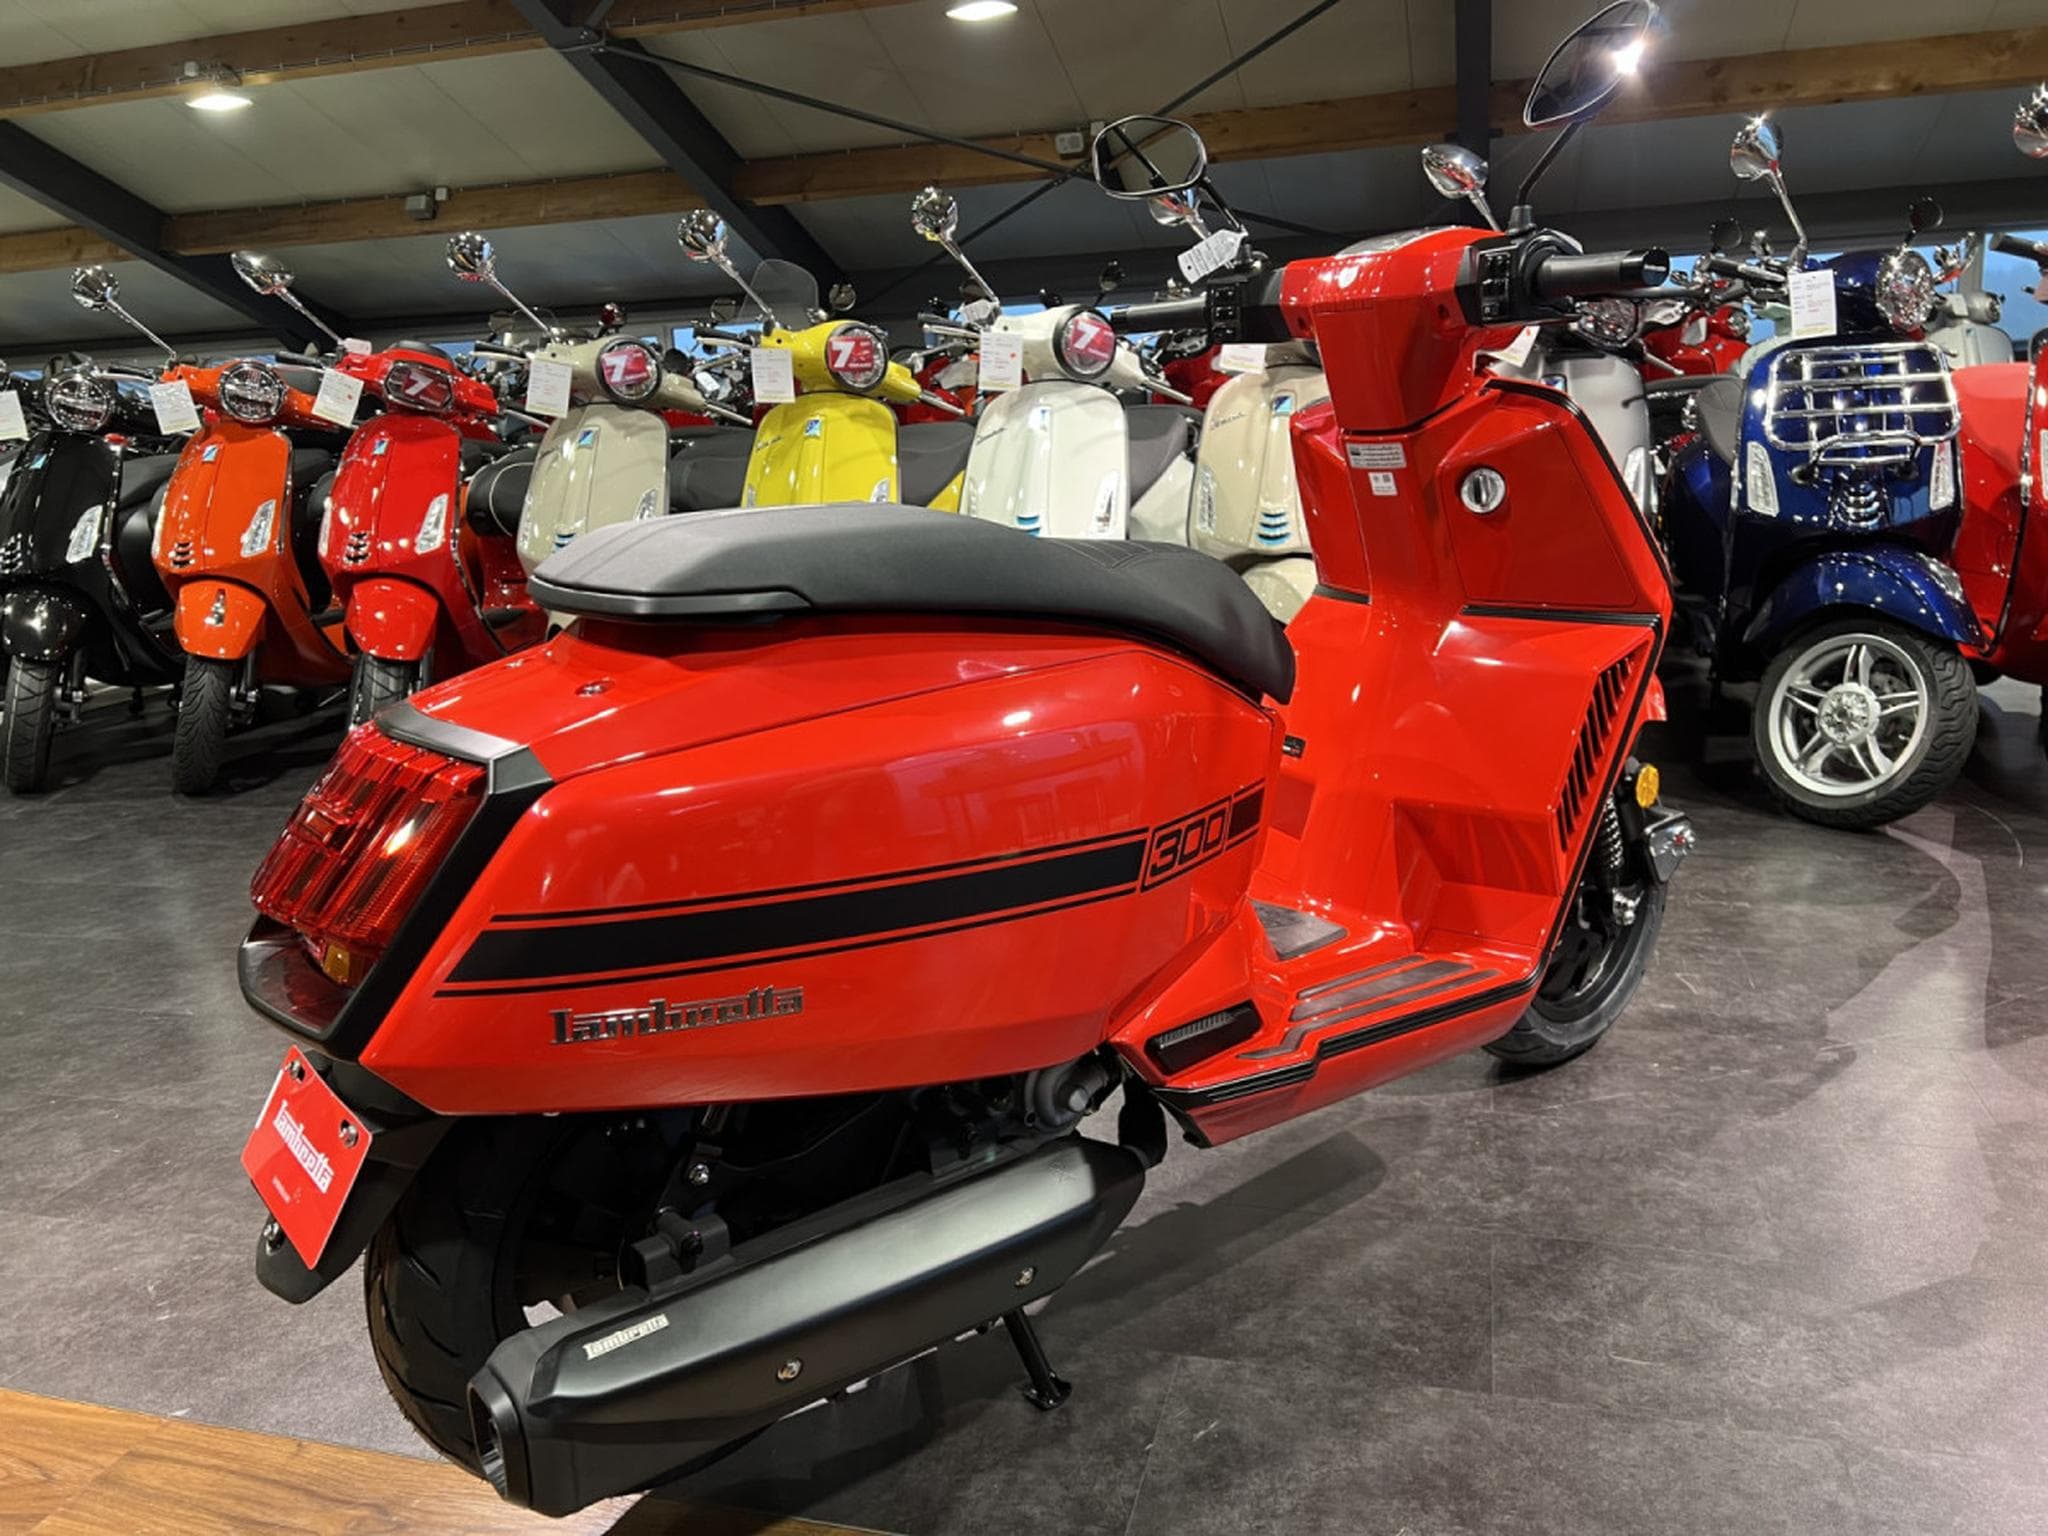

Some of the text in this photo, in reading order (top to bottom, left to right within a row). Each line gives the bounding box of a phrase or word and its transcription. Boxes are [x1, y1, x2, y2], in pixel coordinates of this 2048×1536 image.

[1074, 321, 1100, 350] 7
[831, 340, 855, 368] 7
[605, 355, 628, 383] 7
[405, 371, 434, 396] 7
[1149, 807, 1227, 877] 300
